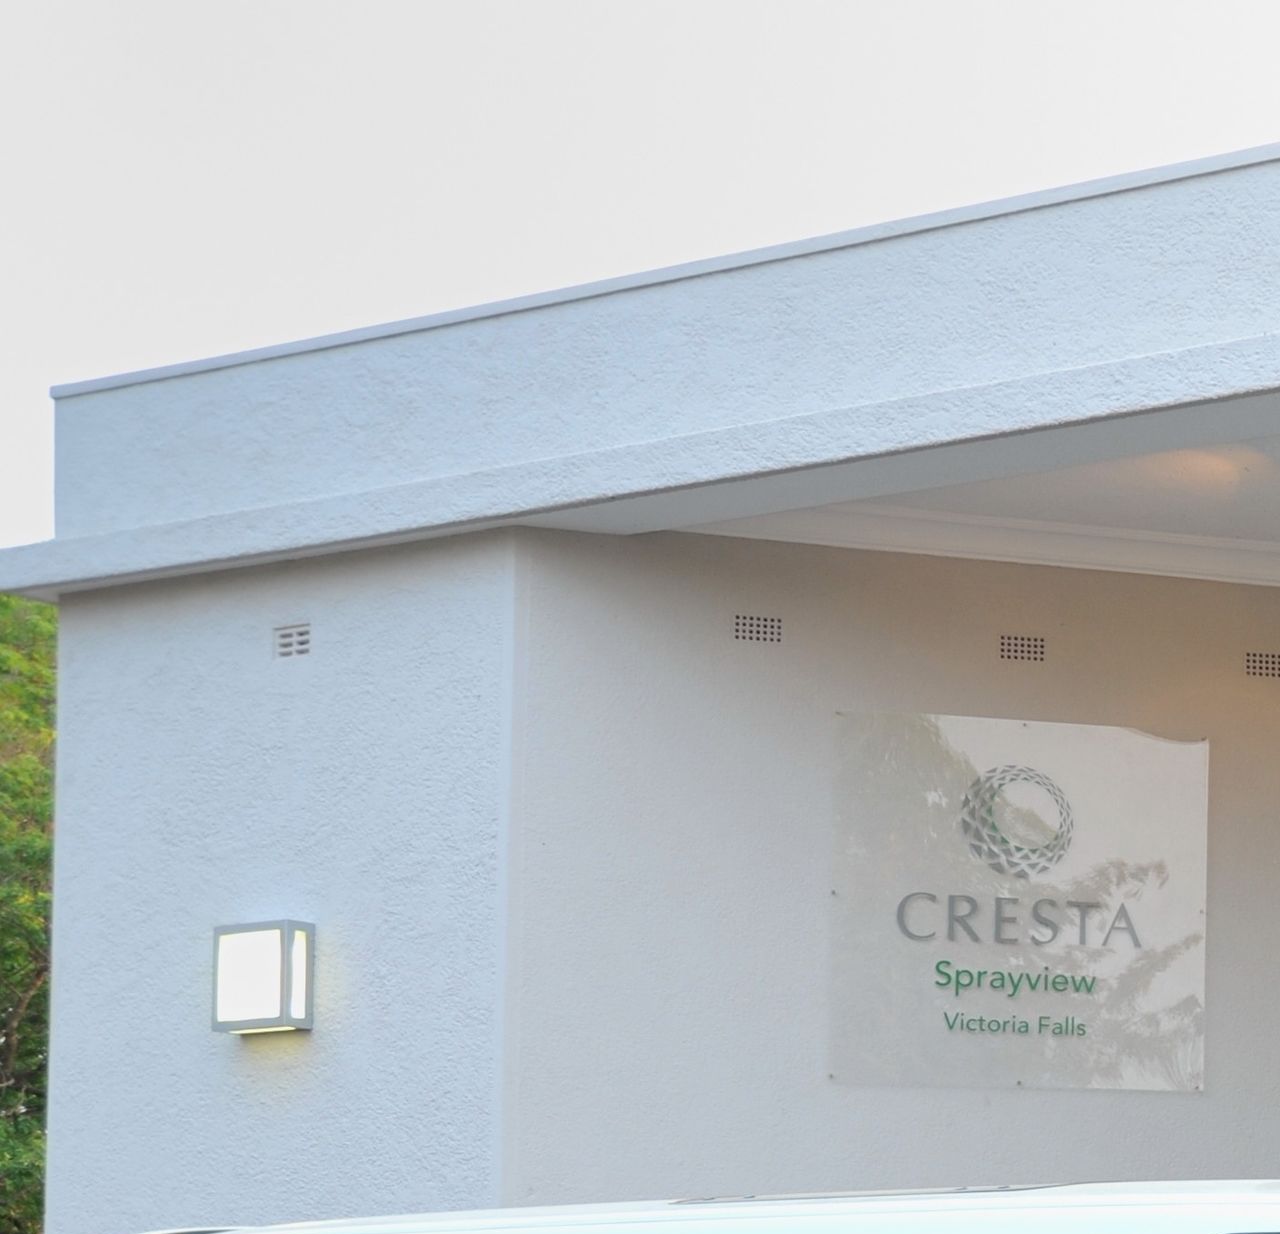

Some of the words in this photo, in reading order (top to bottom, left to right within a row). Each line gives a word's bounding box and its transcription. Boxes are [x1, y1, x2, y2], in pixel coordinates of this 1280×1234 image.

[896, 892, 1141, 948] CRESTA
[934, 960, 1096, 997] Sprayview
[944, 1012, 1029, 1034] Victoria
[1038, 1016, 1086, 1037] Falls
